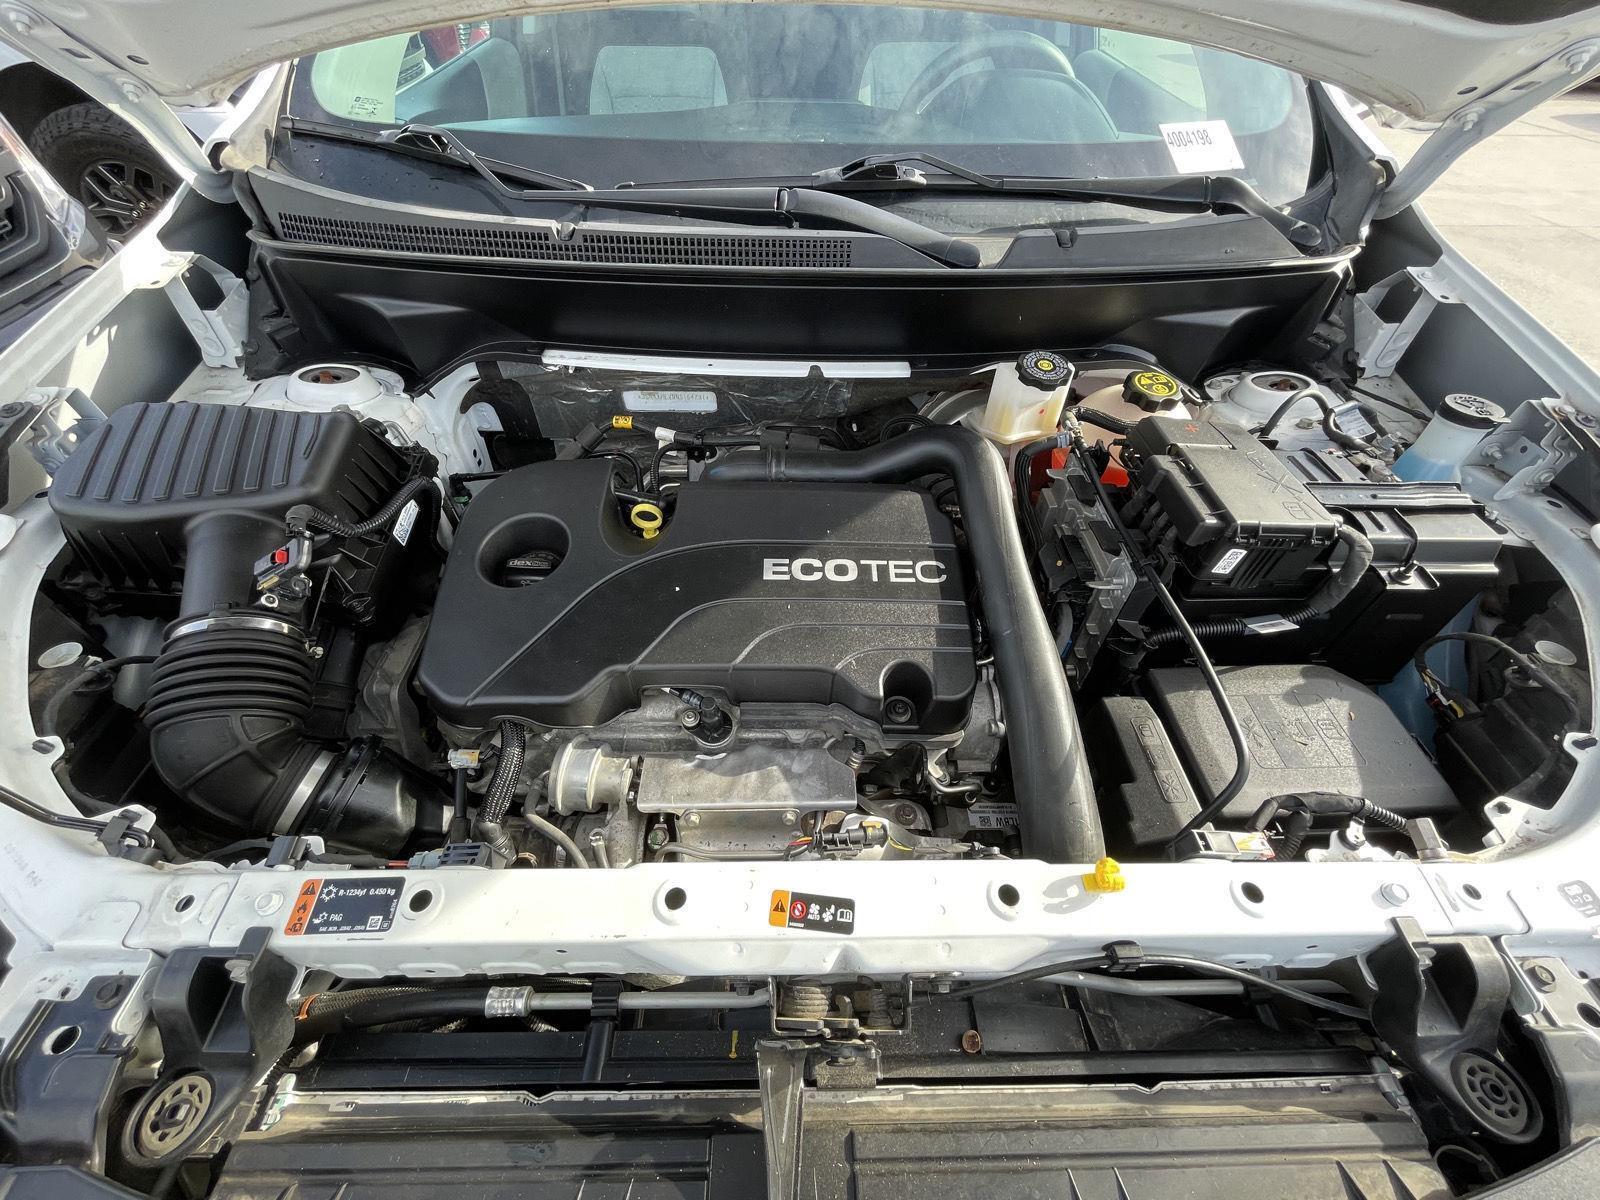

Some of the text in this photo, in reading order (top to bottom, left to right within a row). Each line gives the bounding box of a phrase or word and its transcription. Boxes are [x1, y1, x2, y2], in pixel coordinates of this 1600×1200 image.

[1166, 129, 1212, 147] 4004198
[763, 558, 947, 583] ECOTEC
[338, 887, 396, 897] R-1234yf 0.450 kg
